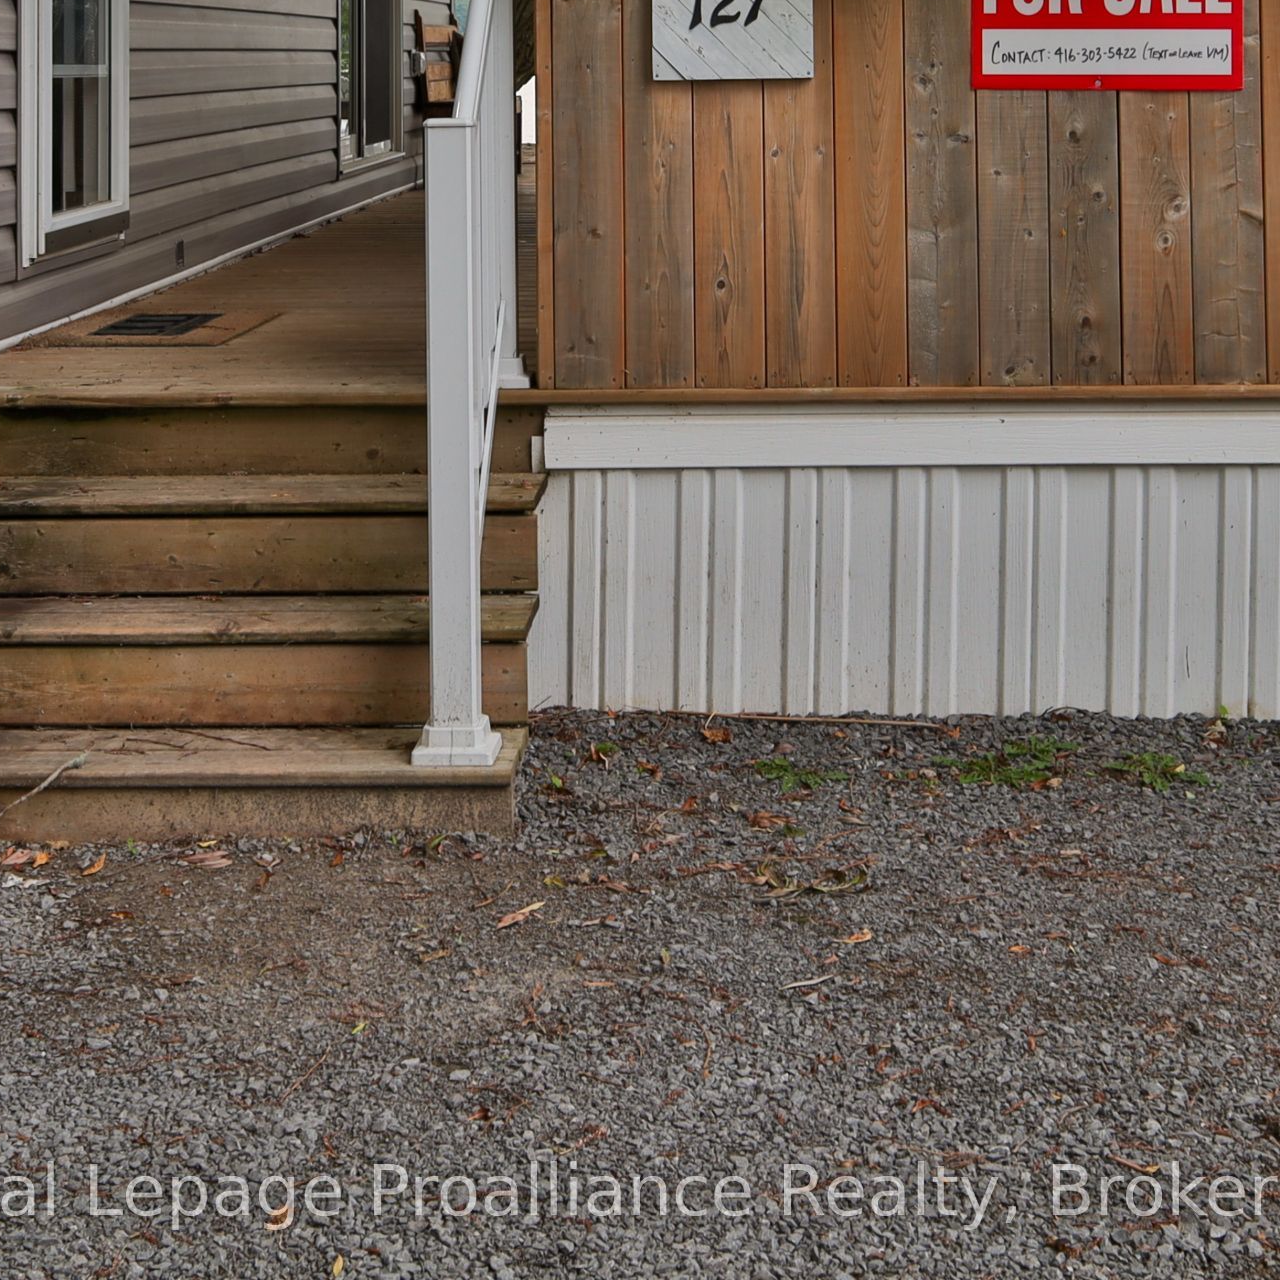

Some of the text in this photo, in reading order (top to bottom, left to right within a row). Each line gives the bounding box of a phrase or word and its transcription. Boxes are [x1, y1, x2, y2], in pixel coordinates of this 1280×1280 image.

[991, 40, 1051, 64] CONTACT:
[1054, 46, 1137, 64] 416-303-5422
[1207, 44, 1229, 62] VM)
